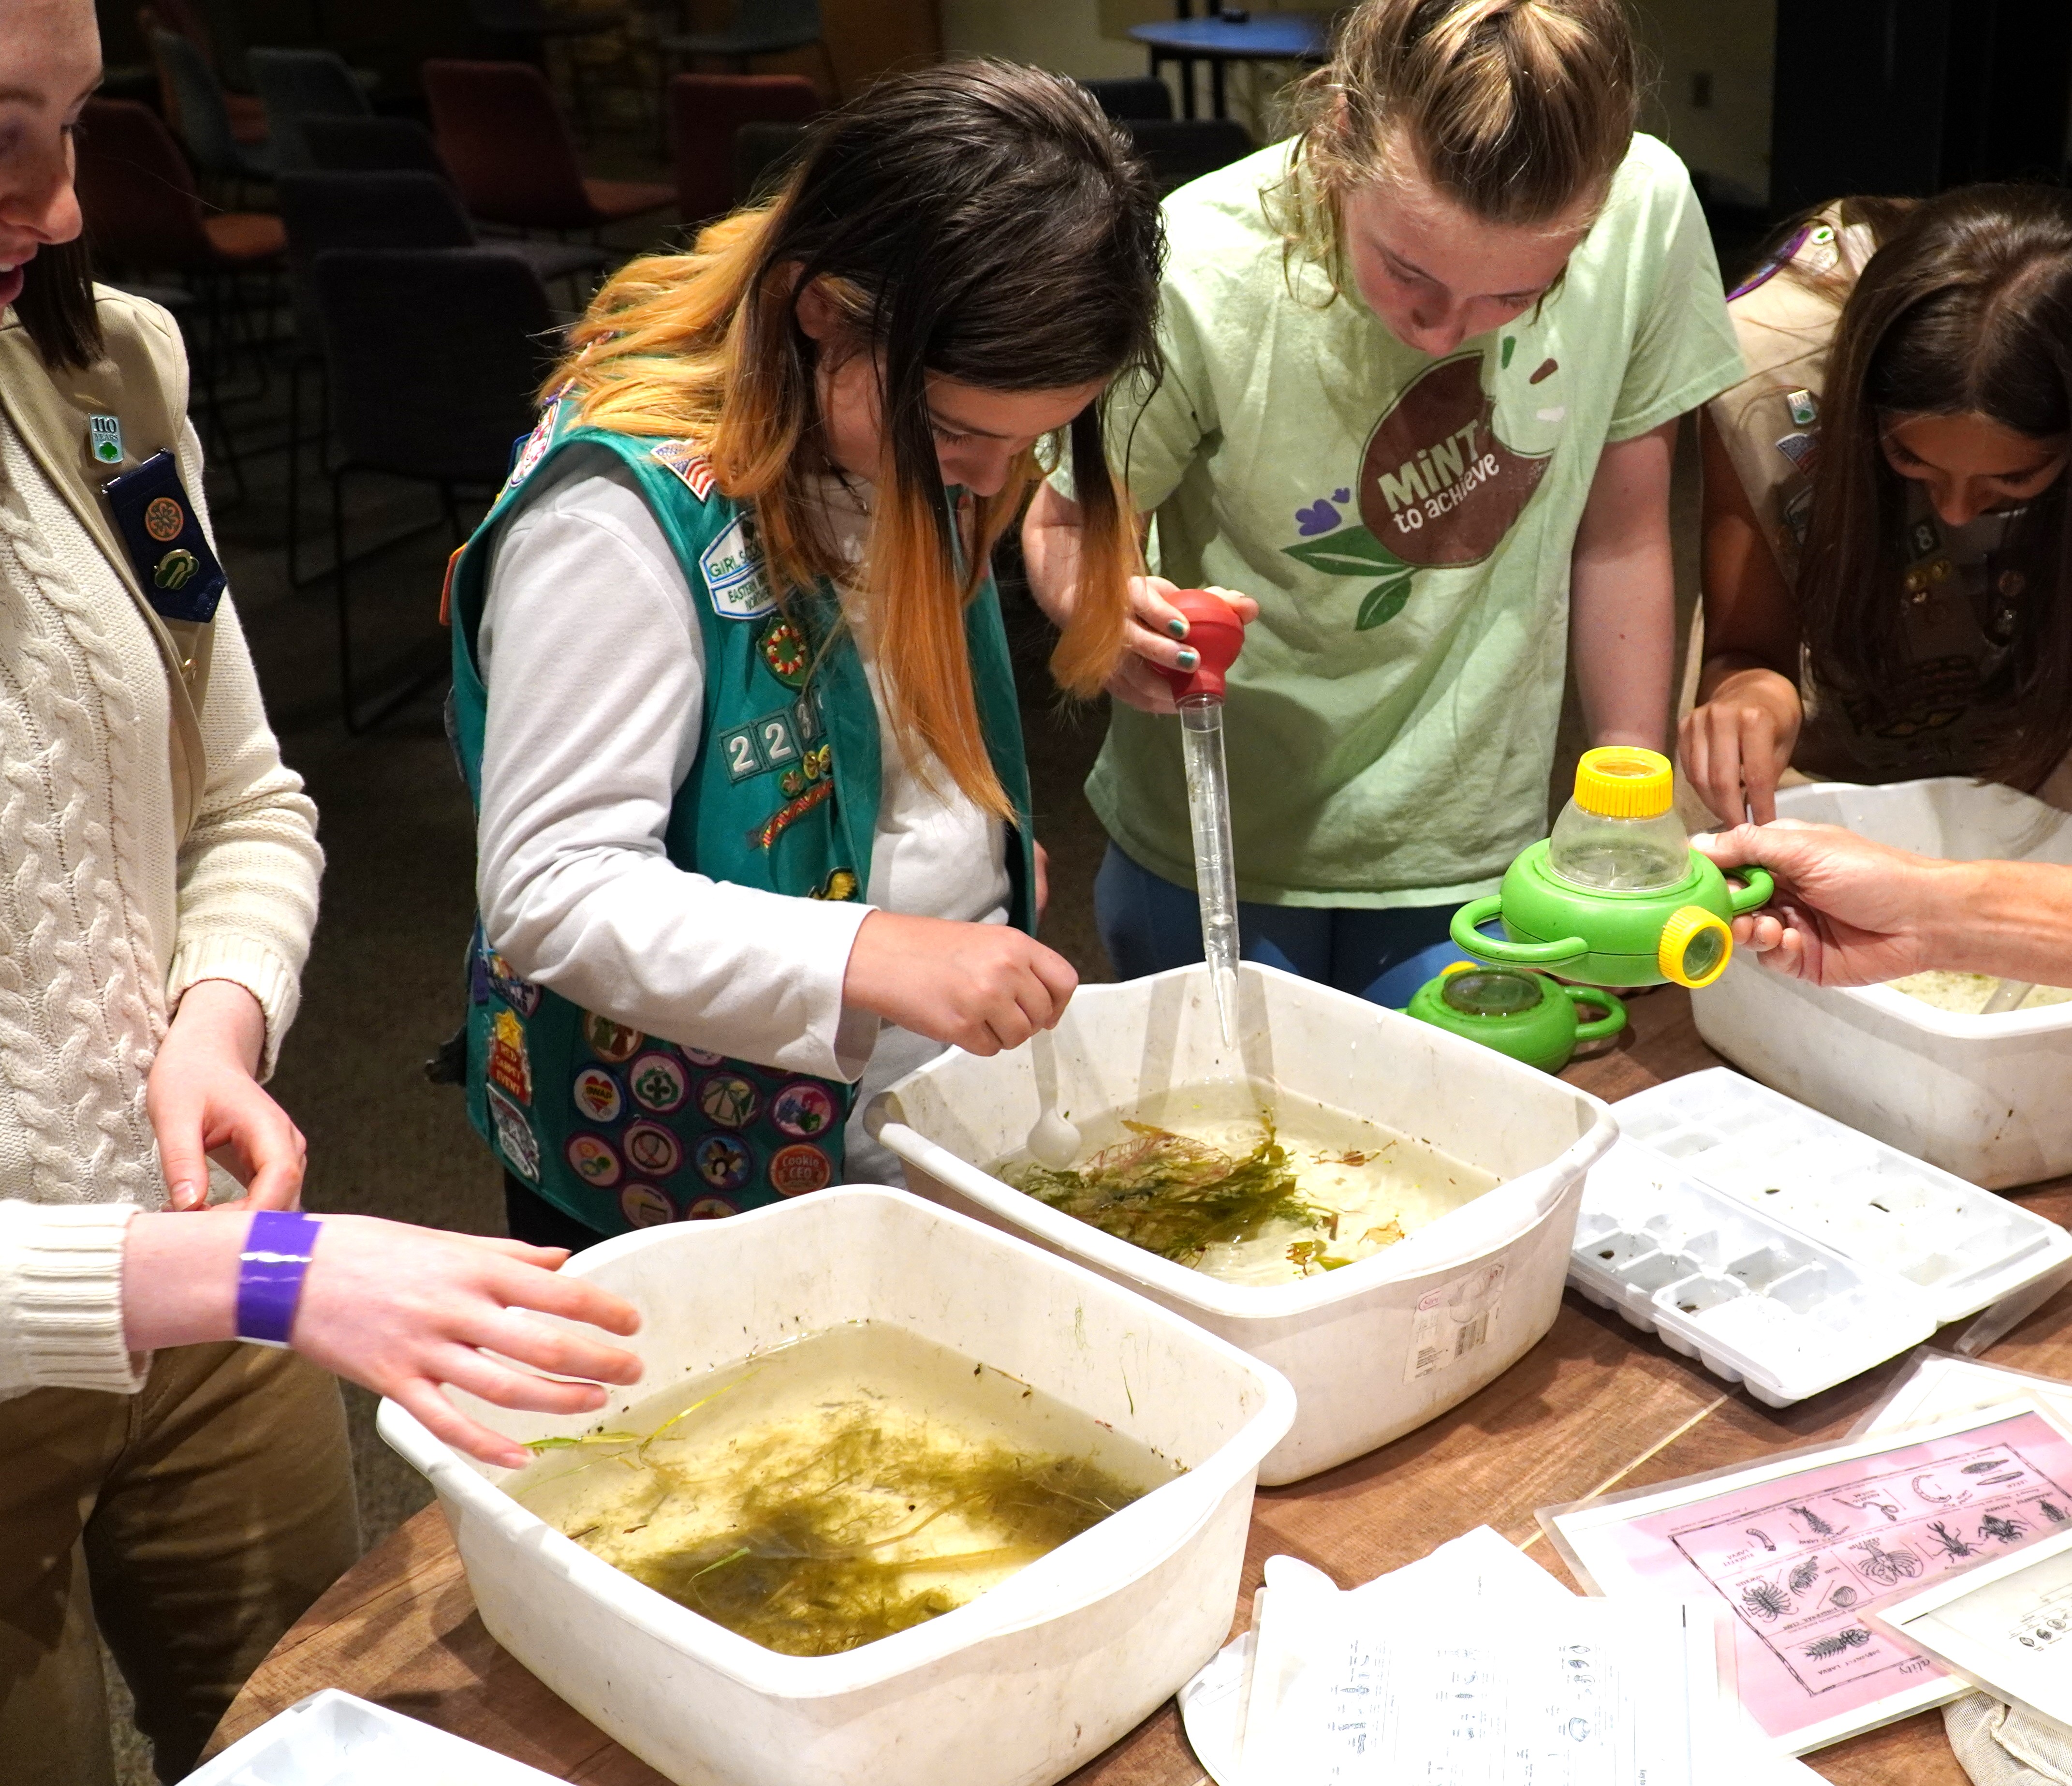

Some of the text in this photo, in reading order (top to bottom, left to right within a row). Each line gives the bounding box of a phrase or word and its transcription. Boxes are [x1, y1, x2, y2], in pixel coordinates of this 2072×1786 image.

[92, 417, 117, 433] 110
[1393, 508, 1423, 532] to
[709, 555, 741, 577] GIRL
[500, 1043, 517, 1063] RED
[496, 1069, 521, 1096] EVENT
[782, 1155, 820, 1167] Cookie
[789, 1166, 812, 1180] CEO
[1726, 1549, 1750, 1560] LARVA
[1735, 1574, 1764, 1587] SOWBUG
[1818, 1649, 1881, 1675] DOBSONFLY LARVA
[1899, 1658, 1931, 1675] ality
[1638, 1769, 1647, 1779] Key
